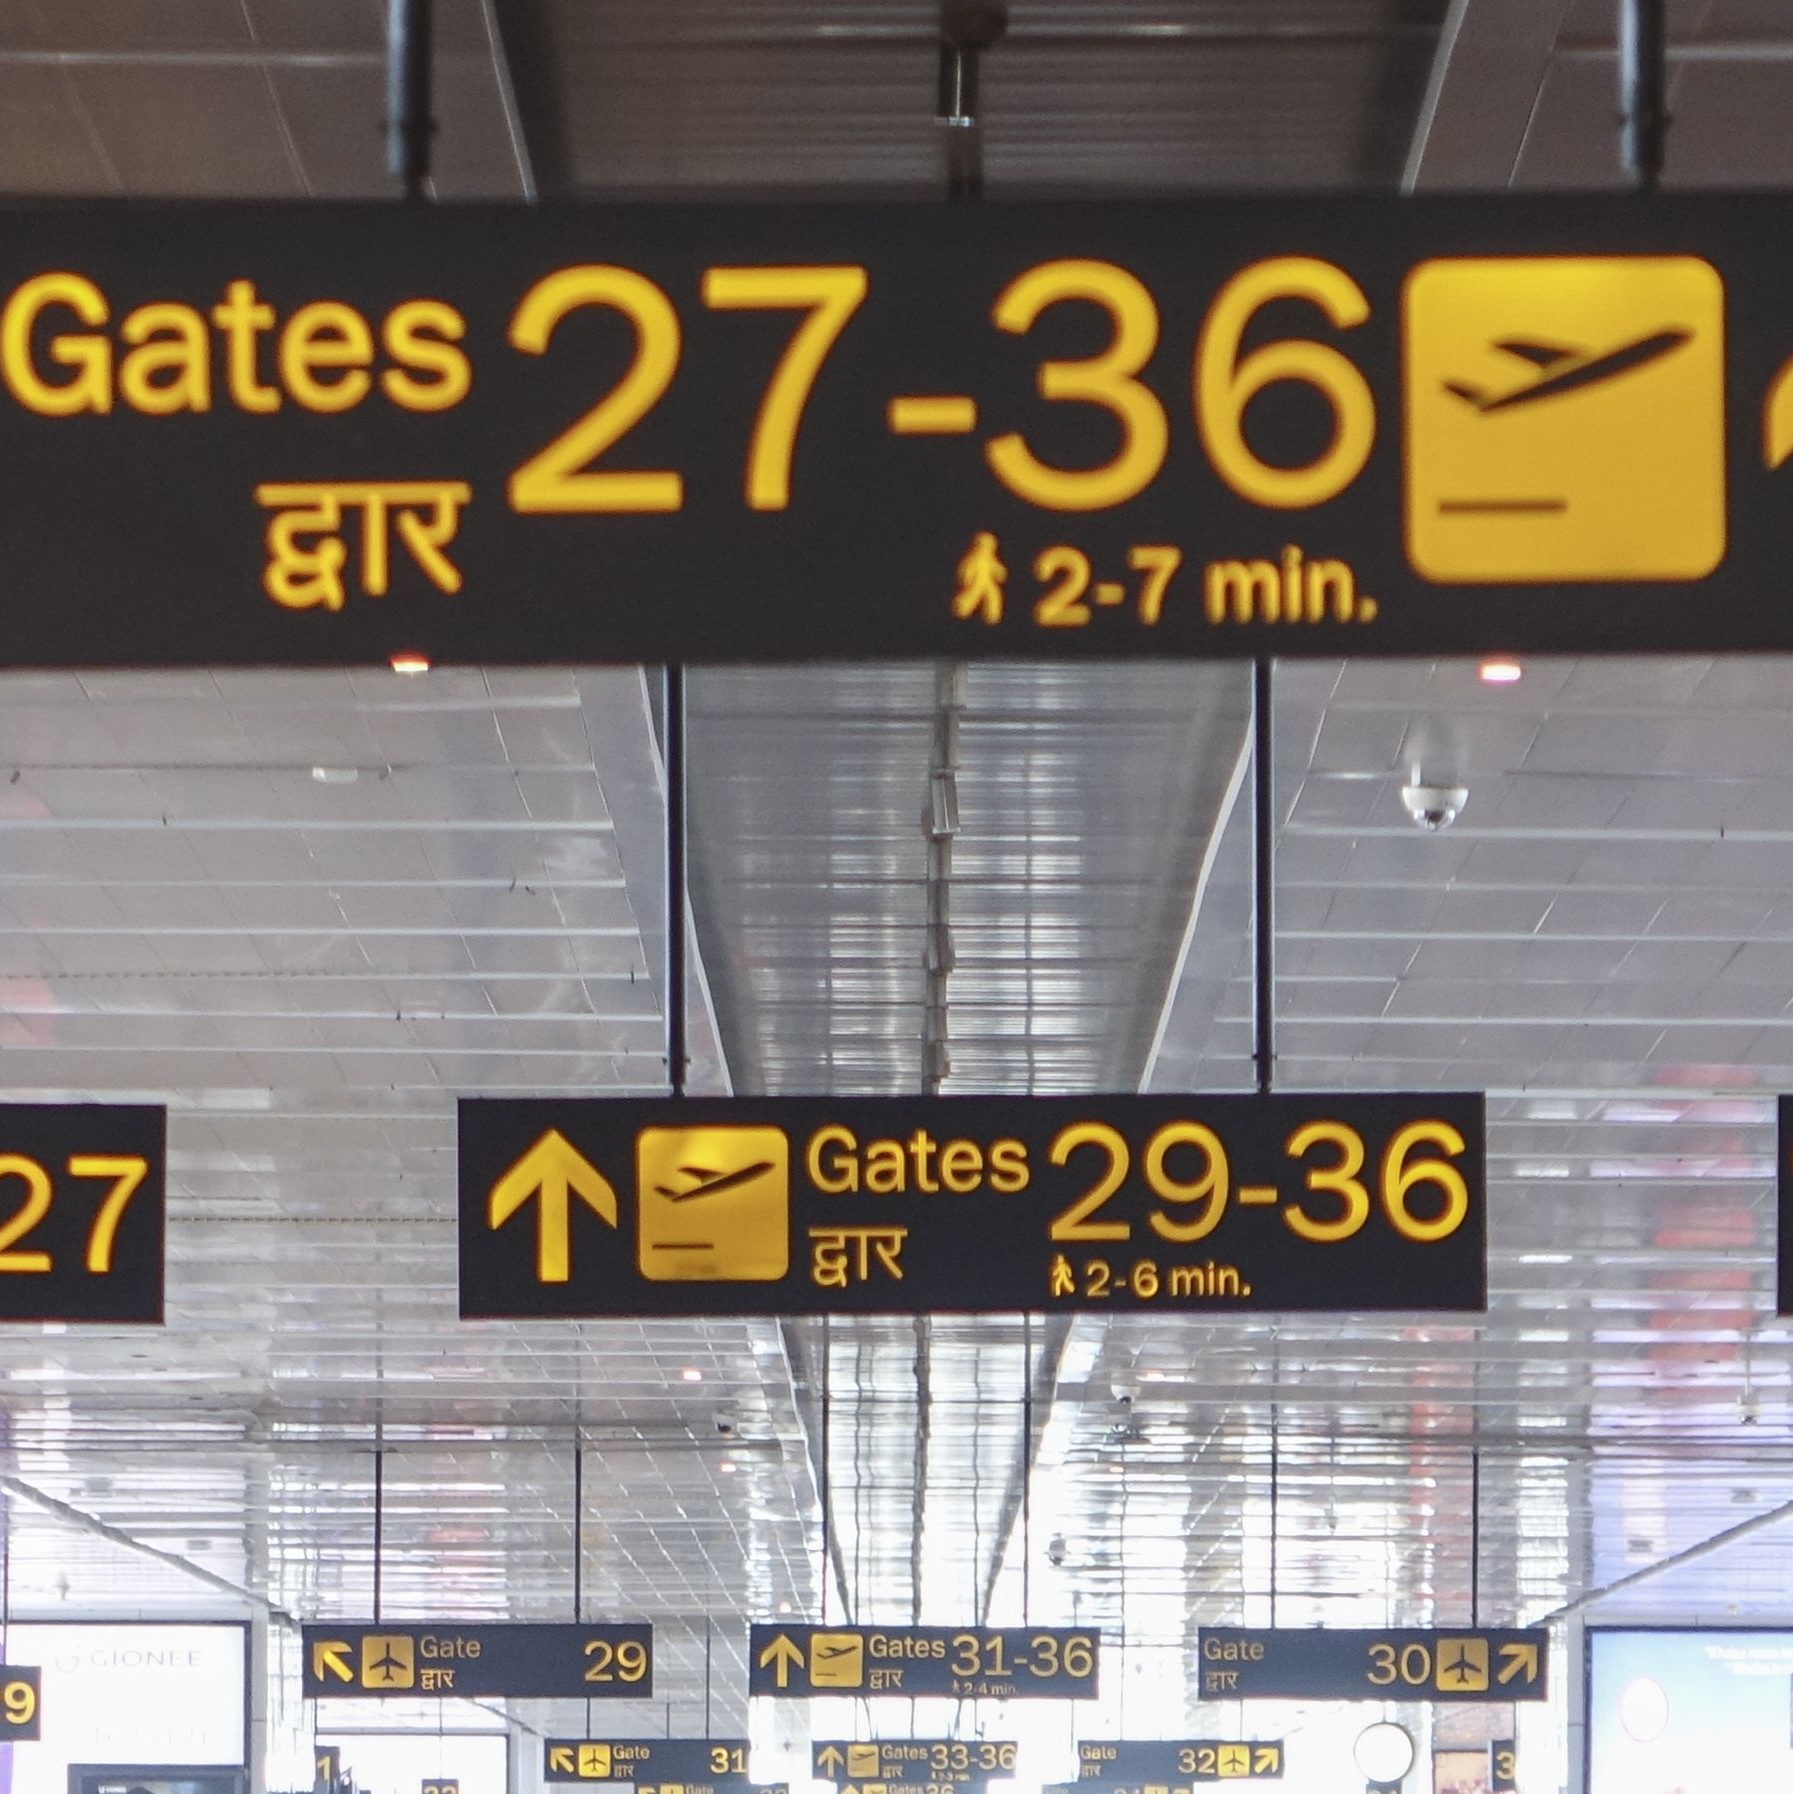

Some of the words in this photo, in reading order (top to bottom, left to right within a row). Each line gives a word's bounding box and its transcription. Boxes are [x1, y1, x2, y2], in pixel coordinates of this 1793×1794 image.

[510, 258, 1376, 513] 27-36
[258, 479, 469, 605] द्वार
[1036, 549, 1175, 624] 2-7
[1207, 542, 1376, 624] min.
[809, 1125, 1029, 1193] Gates
[1049, 1120, 1467, 1243] 29-36
[810, 1226, 907, 1286] द्वार
[1086, 1264, 1157, 1297] 2-6
[1170, 1259, 1251, 1297] min.
[91, 1650, 202, 1666] GIONEE
[420, 1636, 481, 1659] Gate
[584, 1640, 647, 1682] 29
[869, 1634, 946, 1658] Gates
[951, 1634, 1093, 1677] 31-36
[1204, 1637, 1264, 1661] Gate
[1367, 1644, 1431, 1686] 30
[420, 1667, 455, 1691] द्वार
[612, 1745, 650, 1760] Gate
[709, 1747, 747, 1774] 31
[882, 1745, 927, 1760] Gates
[930, 1744, 1017, 1770] 33-36
[1080, 1745, 1117, 1760] Gate
[1178, 1749, 1216, 1773] 32
